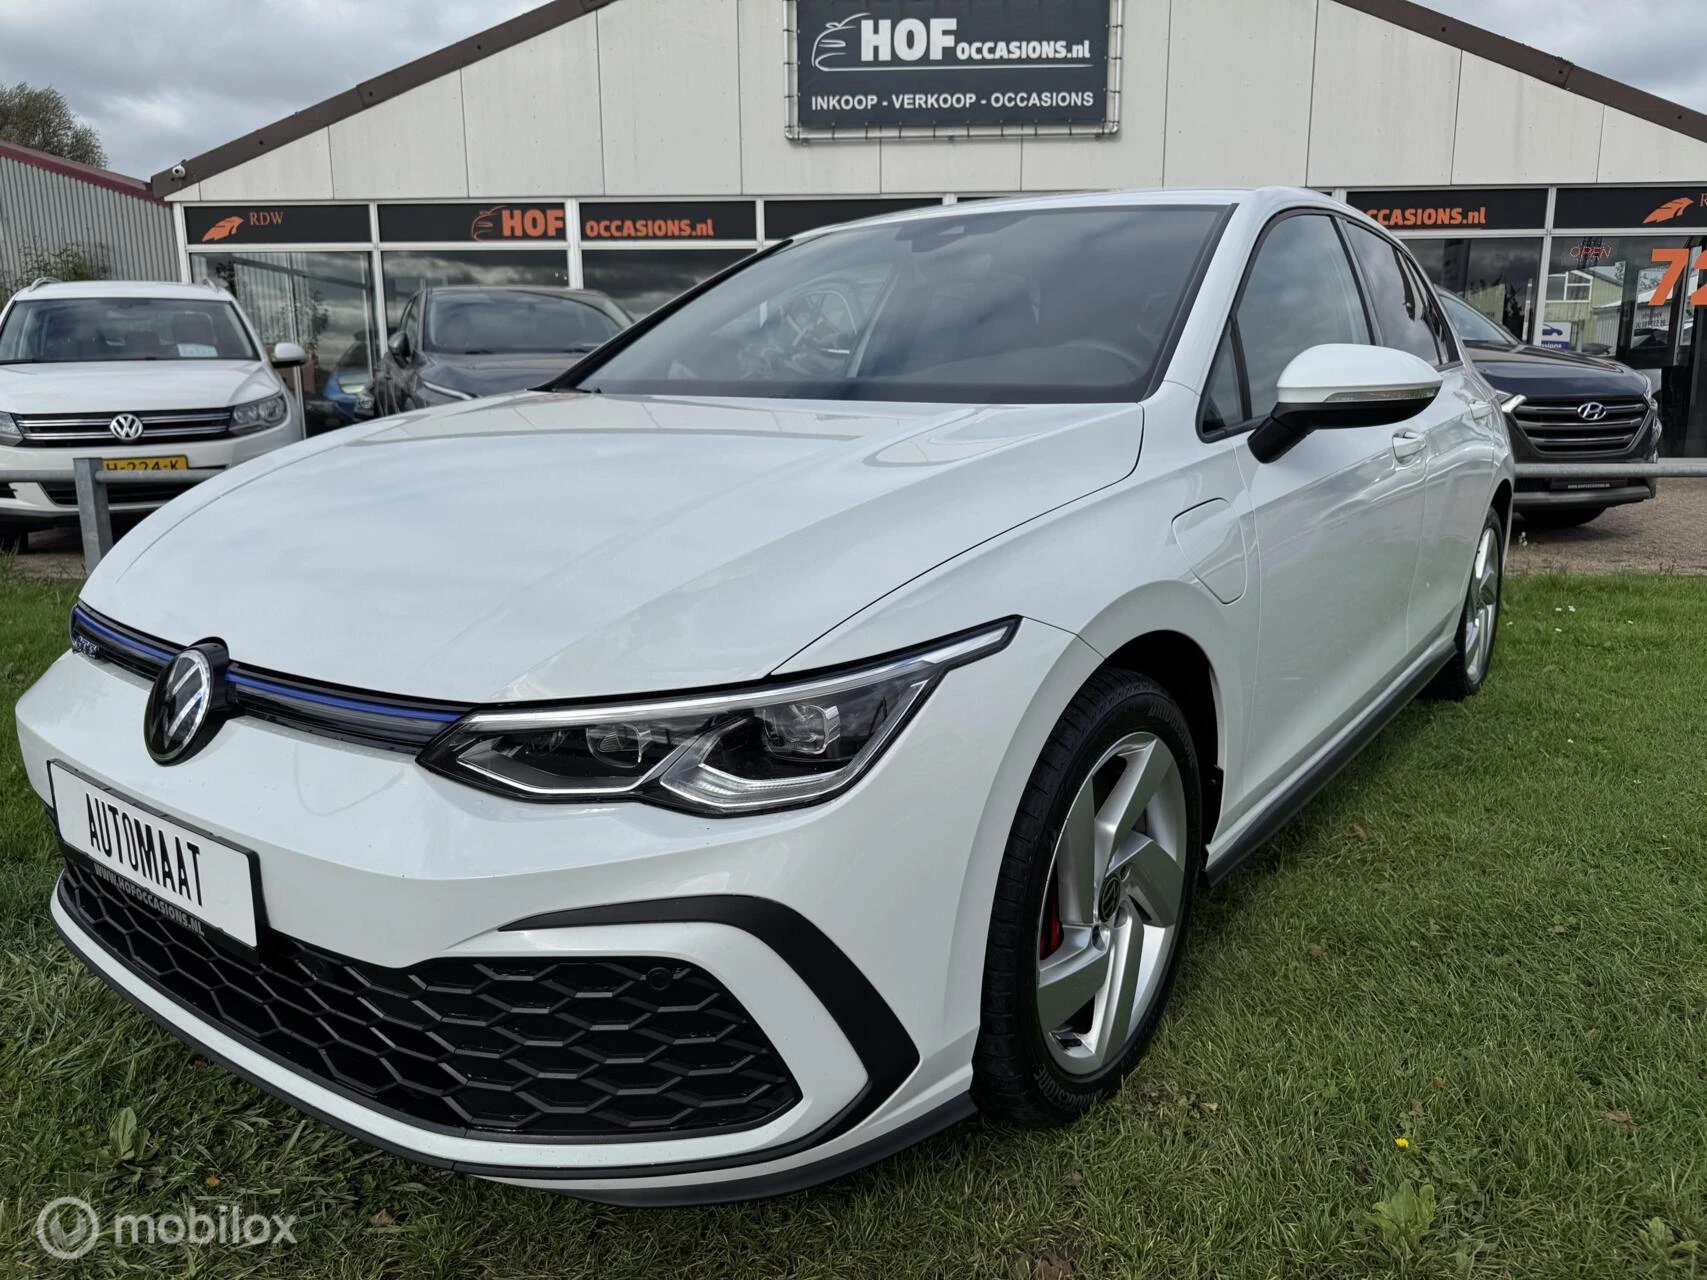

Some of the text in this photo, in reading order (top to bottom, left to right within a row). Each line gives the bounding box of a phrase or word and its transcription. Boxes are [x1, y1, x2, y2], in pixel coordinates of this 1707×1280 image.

[861, 18, 1090, 62] HOF OCCASIONS.nl
[811, 95, 877, 111] INKOOP
[892, 94, 976, 110] VERKOOP
[990, 92, 1094, 107] OCCASIONS
[249, 211, 284, 227] RDW
[502, 209, 714, 239] HOF OCCASIONS.nl
[1569, 245, 1612, 259] OPEN
[86, 792, 203, 907] AUTOMAAT
[93, 862, 205, 937] WWW.HOFOCCASIONS.NL
